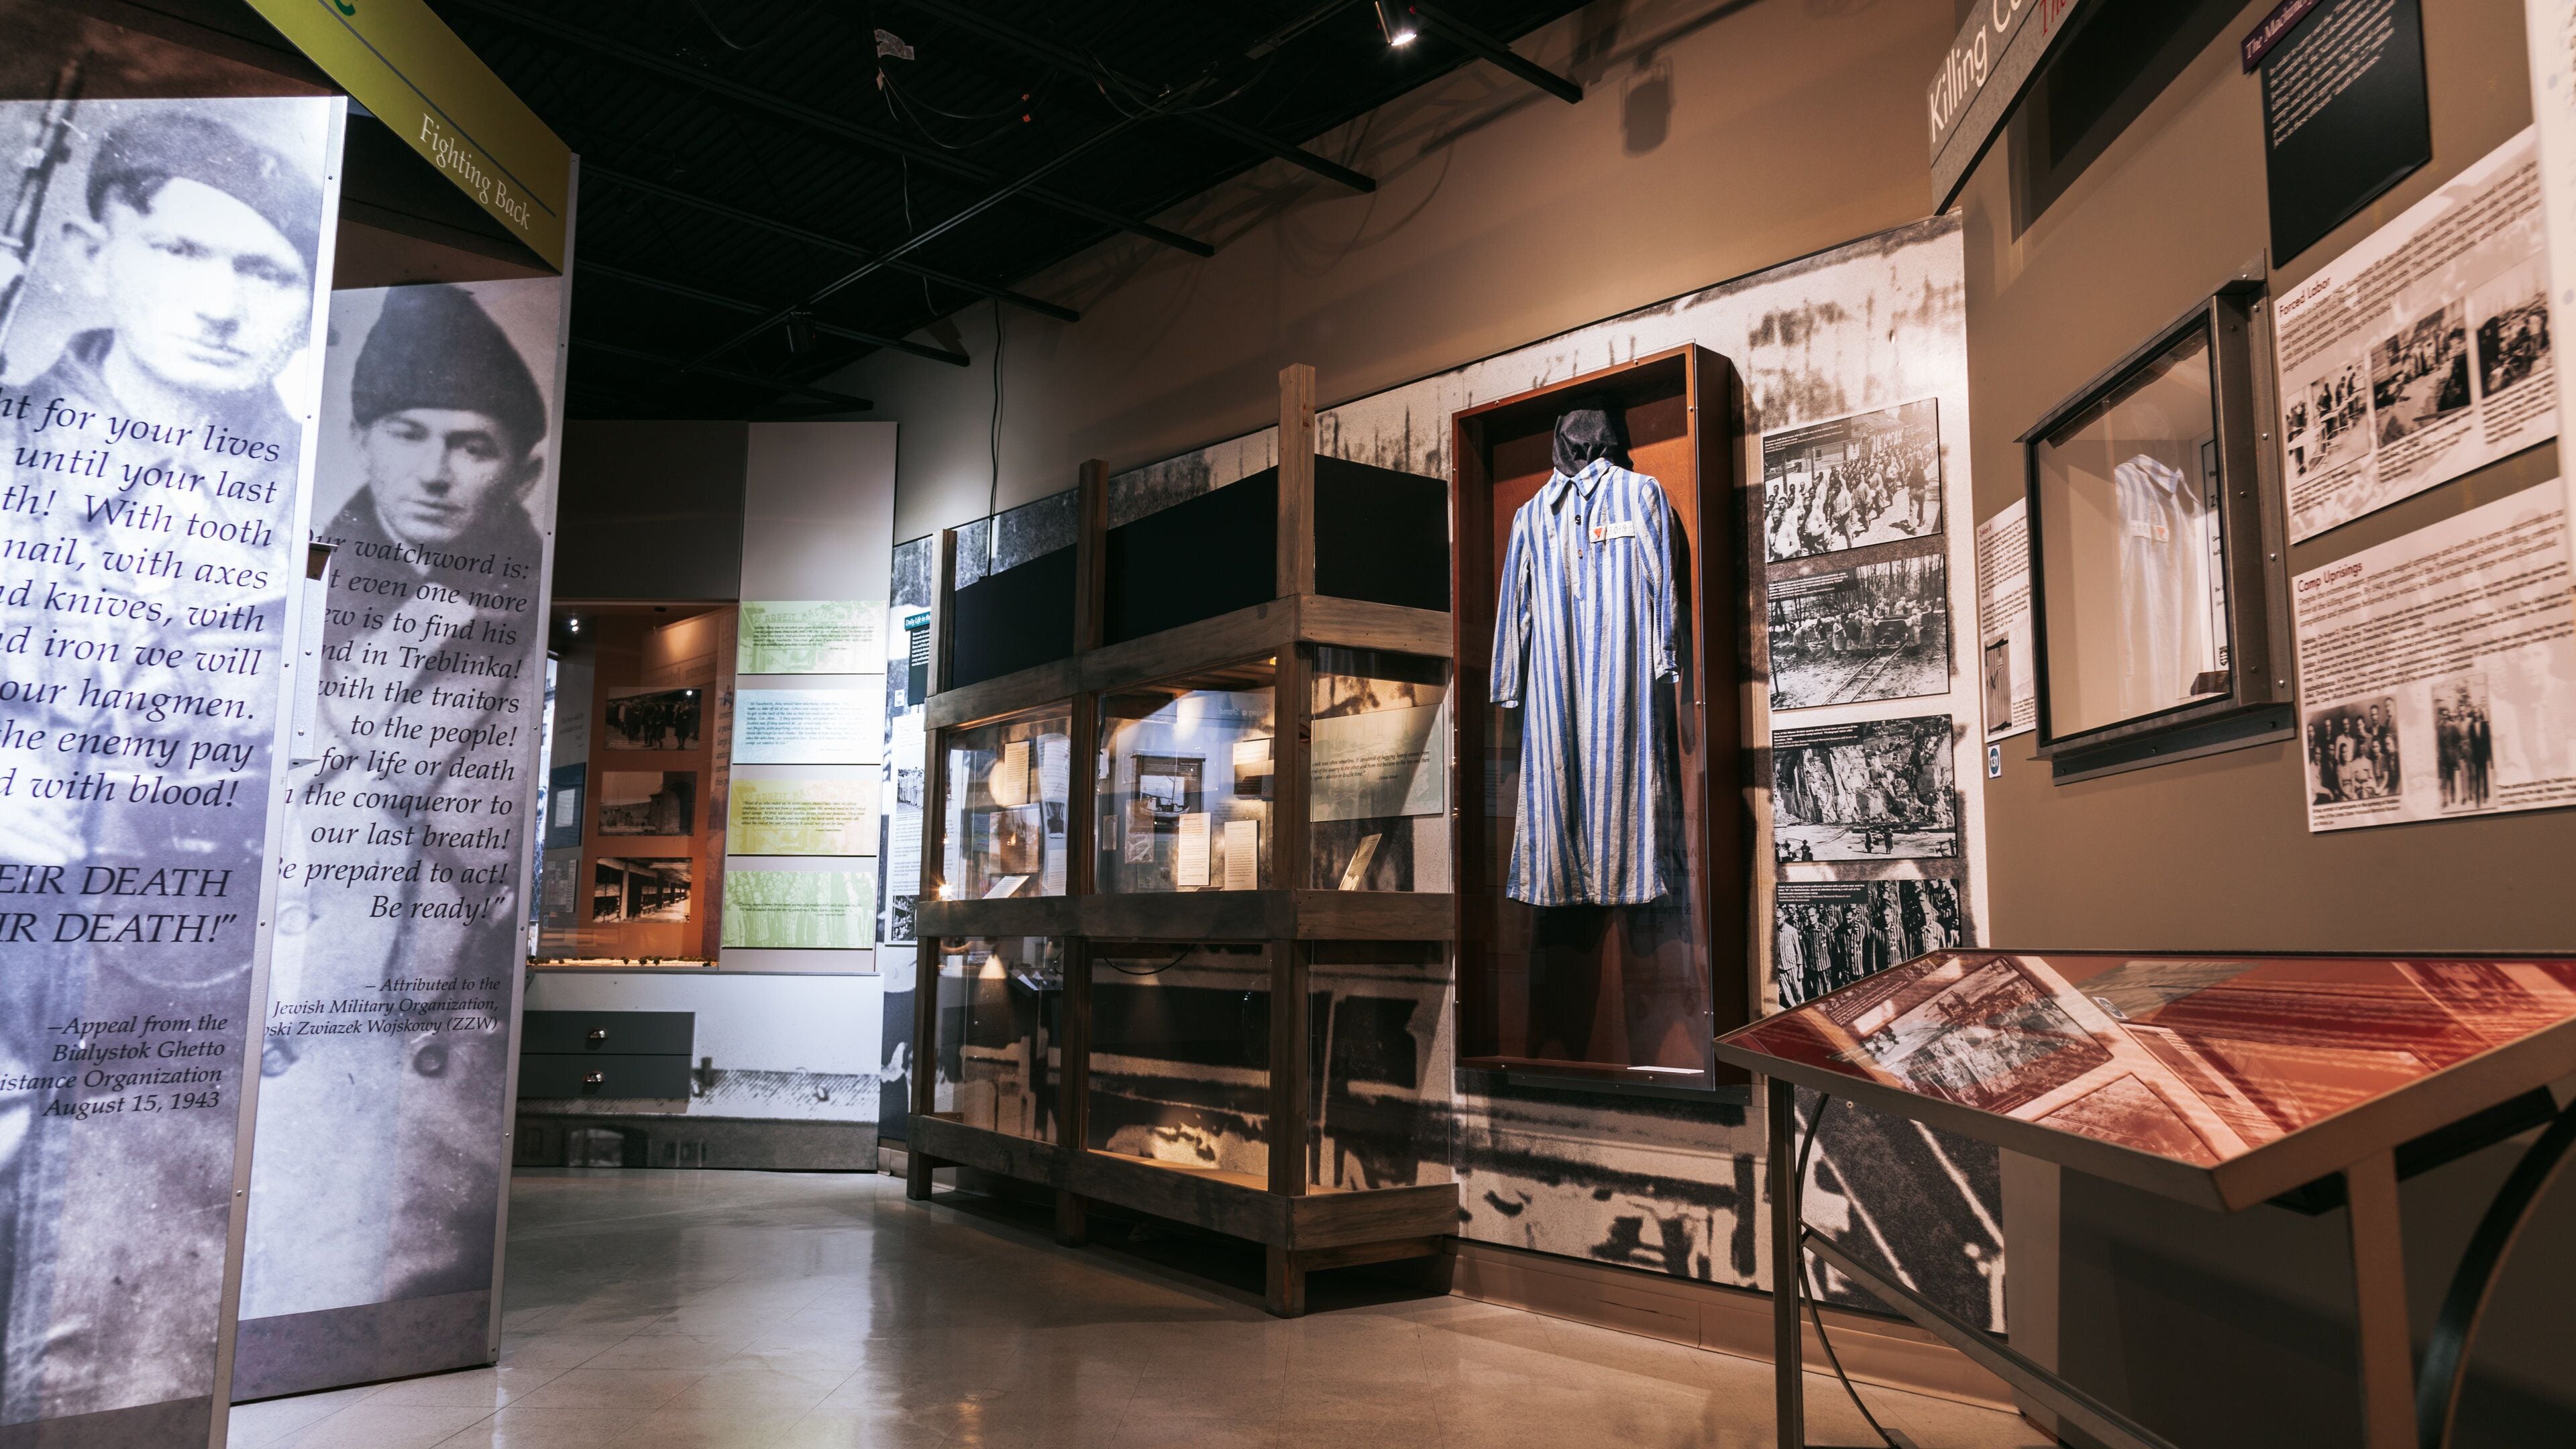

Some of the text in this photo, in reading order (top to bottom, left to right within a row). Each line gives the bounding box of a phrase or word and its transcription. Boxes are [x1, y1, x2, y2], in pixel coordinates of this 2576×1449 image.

[1930, 23, 1988, 144] Killing
[420, 113, 530, 230] Fighting Back
[2279, 277, 2330, 318] Forced Labor
[34, 397, 96, 433] for
[105, 415, 193, 445] your
[203, 425, 280, 462] lives
[15, 446, 278, 504] until your last
[2, 484, 273, 547] th! With tooth
[3, 537, 268, 590] nail, with axes
[354, 540, 496, 574] watchword
[502, 555, 530, 580] is:
[2298, 561, 2363, 592] Camp Uprisings
[44, 581, 173, 627] knives,
[187, 602, 265, 633] with
[347, 575, 408, 597] even
[416, 584, 461, 604] one
[469, 590, 527, 613] more
[363, 606, 384, 629] is
[392, 612, 417, 633] to
[419, 615, 476, 643] find
[482, 621, 517, 645] his
[44, 629, 119, 663] iron
[134, 645, 183, 669] we
[196, 647, 263, 676] will
[362, 642, 388, 666] in
[398, 646, 523, 680] Treblinka!
[0, 678, 254, 722] our hangmen.
[319, 676, 520, 714] with the traitors
[0, 719, 254, 773] he enemy pay
[351, 715, 518, 751] to the people!
[315, 747, 515, 781] for life or death
[30, 770, 117, 802] with
[127, 774, 239, 807] blood!
[305, 782, 346, 806] the
[352, 790, 482, 818] conqueror
[490, 795, 513, 816] to
[311, 822, 511, 850] our last breath!
[79, 865, 233, 898] DEATH
[304, 859, 422, 888] prepared
[430, 866, 453, 883] to
[460, 863, 508, 884] act!
[370, 894, 402, 918] Be
[379, 977, 501, 993] Attributed to the
[140, 1014, 191, 1038] from
[197, 1013, 229, 1031] the
[272, 997, 499, 1018] Jewish Military Organization,
[297, 1018, 363, 1036] Zwiazek
[368, 1018, 443, 1038] Wojskowy
[447, 1016, 498, 1032] (ZZW)
[51, 1039, 225, 1067] Bialystok Ghetto
[84, 1065, 223, 1093] Organization
[42, 1091, 220, 1121] August 15, 1943
